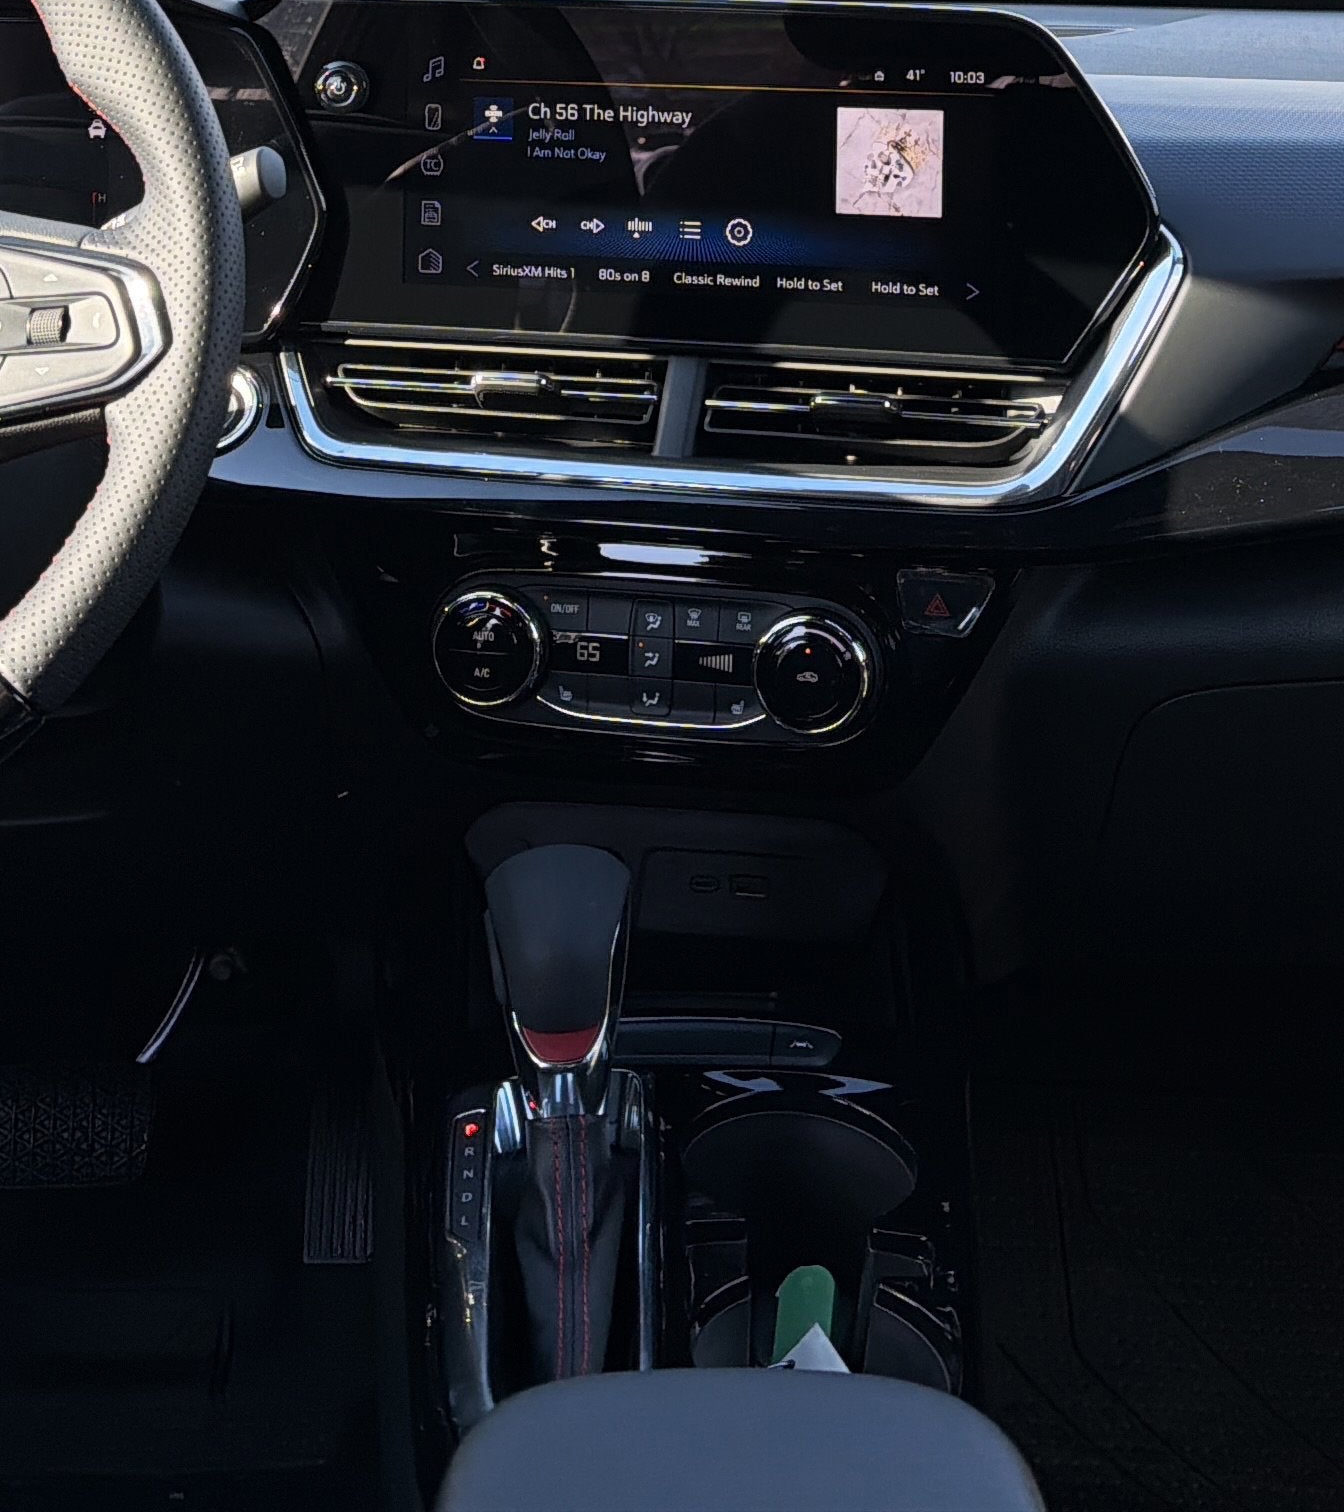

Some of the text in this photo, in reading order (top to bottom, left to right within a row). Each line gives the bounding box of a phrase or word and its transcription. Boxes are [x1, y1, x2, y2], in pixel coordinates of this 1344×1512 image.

[950, 72, 984, 83] 10:03
[528, 103, 692, 127] Ch 56 The Highway
[528, 129, 574, 142] Jelly Roll
[533, 148, 551, 157] Am
[555, 148, 575, 158] Not
[578, 148, 606, 162] Okay
[493, 265, 574, 278] SiriusXM Hits 1
[599, 269, 649, 282] 80s on 8
[673, 272, 760, 287] Classic Rewind
[777, 277, 843, 291] Hold to Set
[872, 282, 939, 296] Hold to Set
[550, 604, 580, 614] ON/OFF
[472, 632, 494, 641] AUTO
[576, 642, 600, 662] 65
[474, 668, 490, 678] A/C
[465, 1147, 474, 1156] R
[463, 1169, 474, 1179] N
[461, 1193, 472, 1202] D
[460, 1216, 468, 1225] L
